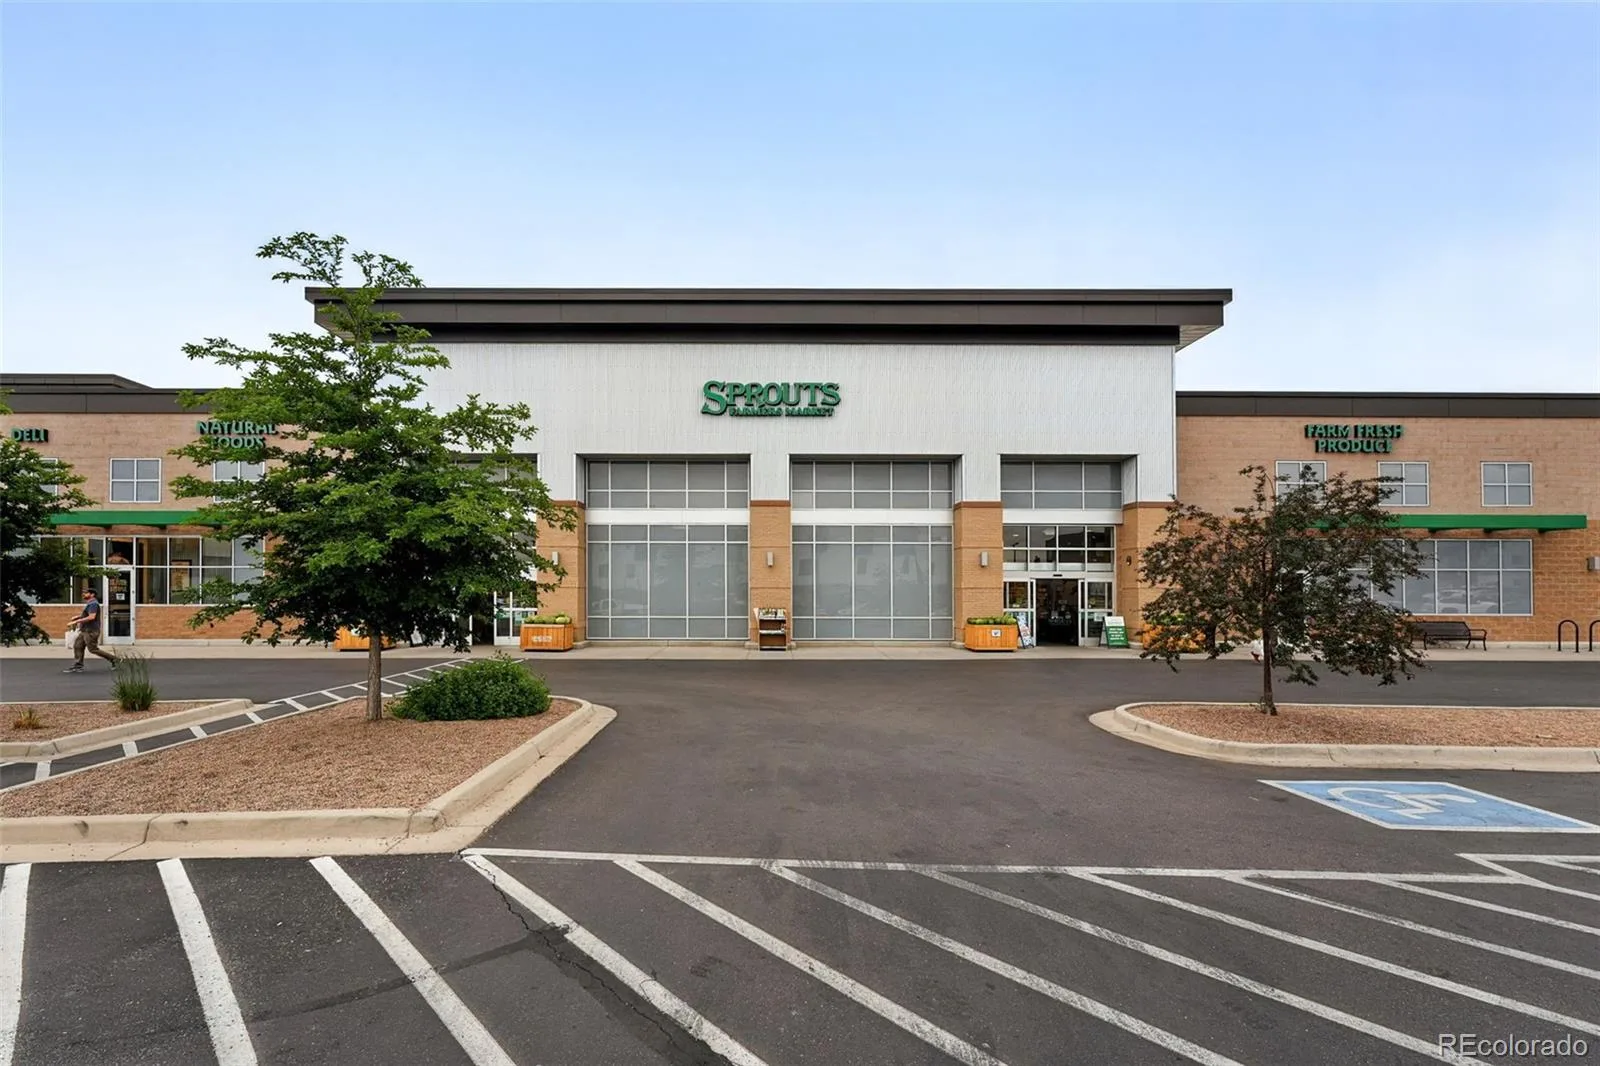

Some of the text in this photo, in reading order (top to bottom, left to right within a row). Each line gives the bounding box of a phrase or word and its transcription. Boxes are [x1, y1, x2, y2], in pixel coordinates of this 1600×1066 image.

[701, 380, 841, 416] SPROUTS
[728, 407, 834, 417] FARMERS MARKET
[11, 427, 48, 442] DELI
[1304, 424, 1405, 438] FARM FRESH
[1315, 439, 1393, 453] PRODUCE
